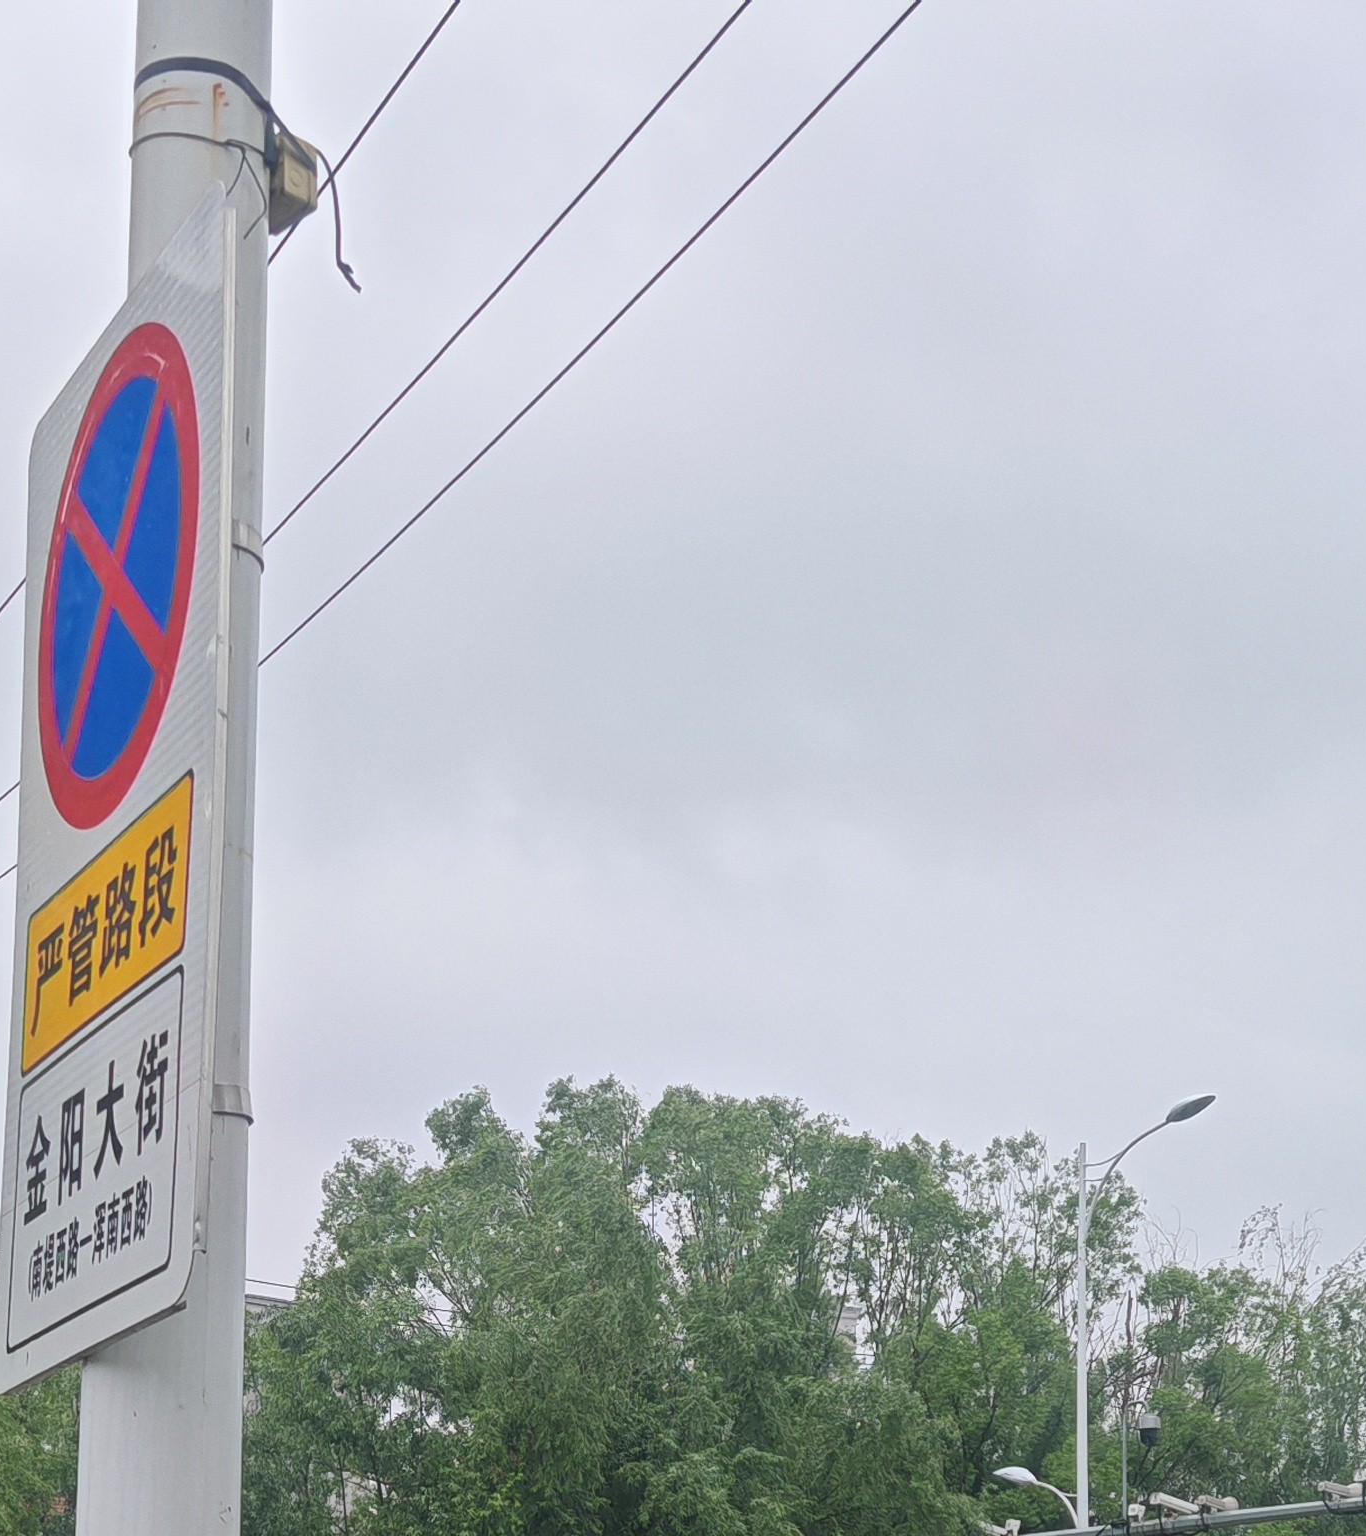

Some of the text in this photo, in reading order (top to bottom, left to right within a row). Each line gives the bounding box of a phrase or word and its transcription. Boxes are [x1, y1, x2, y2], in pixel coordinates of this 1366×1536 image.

[31, 825, 177, 1037] 严管路段
[24, 1029, 169, 1226] 金阳大街
